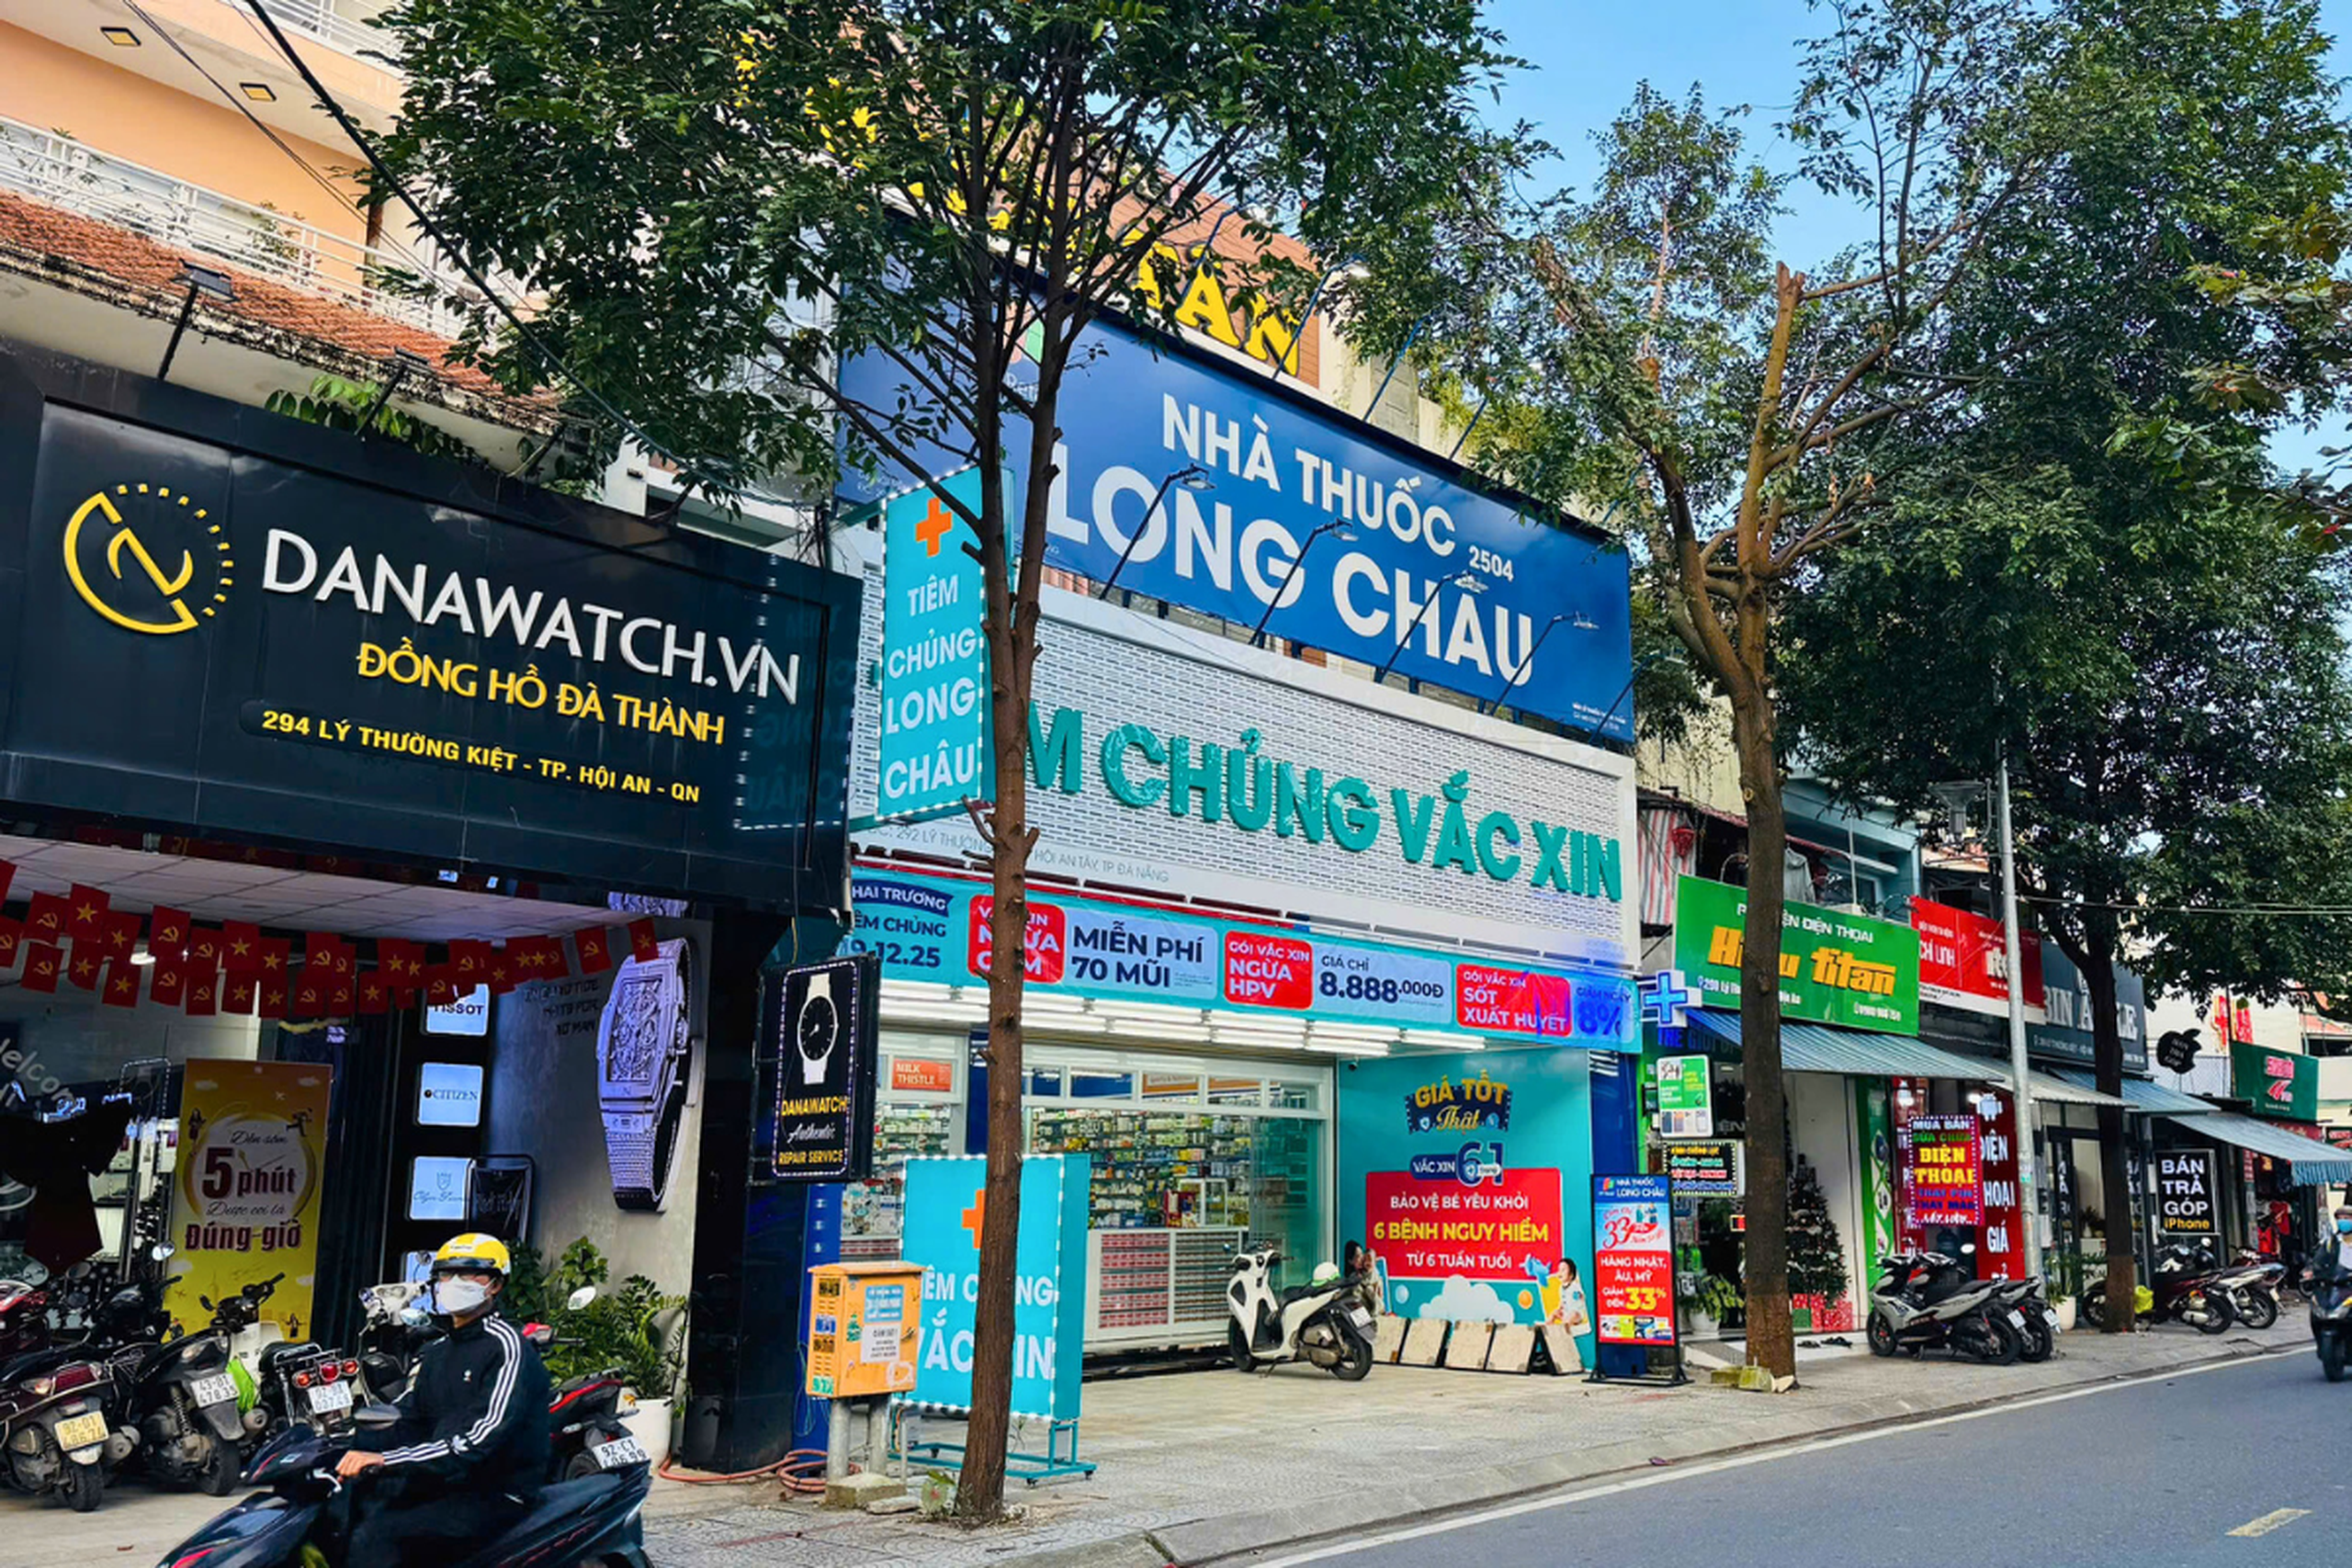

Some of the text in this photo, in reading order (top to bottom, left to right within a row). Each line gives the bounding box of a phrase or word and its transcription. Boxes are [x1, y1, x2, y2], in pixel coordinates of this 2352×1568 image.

[1162, 392, 1456, 556] NHÀ THUỐC
[1046, 442, 1533, 687] LONG CHÂU
[1469, 545, 1514, 582] 2504
[908, 574, 958, 616] TIÊM
[262, 528, 801, 705] DANAWATCH.VN
[888, 627, 977, 679] CHỦNG
[356, 637, 725, 745] ĐỒNG HỒ ĐÀ THÀNH
[886, 677, 975, 735] LONG
[262, 709, 700, 803] 294 LÝ THƯỜNG KIỆT TP. HỘI AN QN
[884, 739, 975, 799] CHÂU
[1101, 728, 1380, 852] CHỦNG
[1391, 769, 1521, 882] VẮC
[1531, 819, 1623, 902] XIN
[897, 826, 920, 840] 292
[922, 829, 938, 843] LÝ
[1058, 853, 1077, 867] AN
[852, 886, 947, 911] HAI TRƯƠNG
[854, 911, 947, 938] ÊM CHỦNG
[978, 923, 1060, 953] NỪA
[1802, 916, 1832, 935] ĐIỆN
[1835, 924, 1874, 943] THOẠI
[843, 937, 942, 969] 912.25
[1072, 921, 1205, 964] MIỄN PHÍ
[1229, 939, 1310, 963] GÓI VẮC XIN
[977, 951, 1042, 975] CM
[1071, 955, 1108, 981] 70
[1115, 954, 1171, 987] MŨI
[1229, 957, 1293, 982] NGỪA
[1321, 953, 1370, 972] GIÁ CHỈ
[1229, 978, 1275, 999] HPV
[1463, 969, 1481, 983] GÓI
[1509, 976, 1527, 989] XIN
[1463, 984, 1498, 1005] SỐT
[434, 1003, 484, 1015] TISSOT
[1463, 1005, 1567, 1032] XUẤT HUYẾT
[1577, 1000, 1621, 1037] 8%
[896, 1063, 921, 1074] MILK
[897, 1073, 935, 1085] THISTLE
[433, 1089, 479, 1100] CITIZEN
[1415, 1068, 1508, 1108] GIÁ TỐT
[781, 1096, 847, 1116] DANAWATCH
[1436, 1104, 1482, 1134] Thật
[1912, 1120, 1940, 1130] MUA
[778, 1149, 843, 1165] REPAIR SERVICE
[1413, 1157, 1434, 1172] VẮC
[1437, 1161, 1455, 1173] XIN
[1919, 1143, 1965, 1167] ĐIỆN
[2161, 1155, 2204, 1175] BÁN
[202, 1146, 298, 1200] 5 phút
[1914, 1168, 1974, 1188] THOẠI
[2161, 1174, 2205, 1195] TRẢ
[1391, 1191, 1529, 1212] BẢO VỆ BÉ YÊU KHỎI
[1983, 1181, 2016, 1212] HOẠI
[2164, 1197, 2209, 1216] GÓP
[185, 1217, 303, 1252] Đúng giờ
[1374, 1215, 1548, 1245] 6 BỆNH NGUY HIỂM
[1602, 1215, 1632, 1249] 33
[1986, 1220, 2010, 1254] GIÁ
[2164, 1218, 2211, 1230] iPhone
[1407, 1249, 1511, 1269] TỪ 6 TUẦN TUỔI
[1601, 1255, 1667, 1269] HÀNG NHẬT,
[922, 1265, 1055, 1307] ÊM CNG
[1614, 1269, 1653, 1283] ÂU, MỸ
[1015, 1334, 1053, 1379] IN
